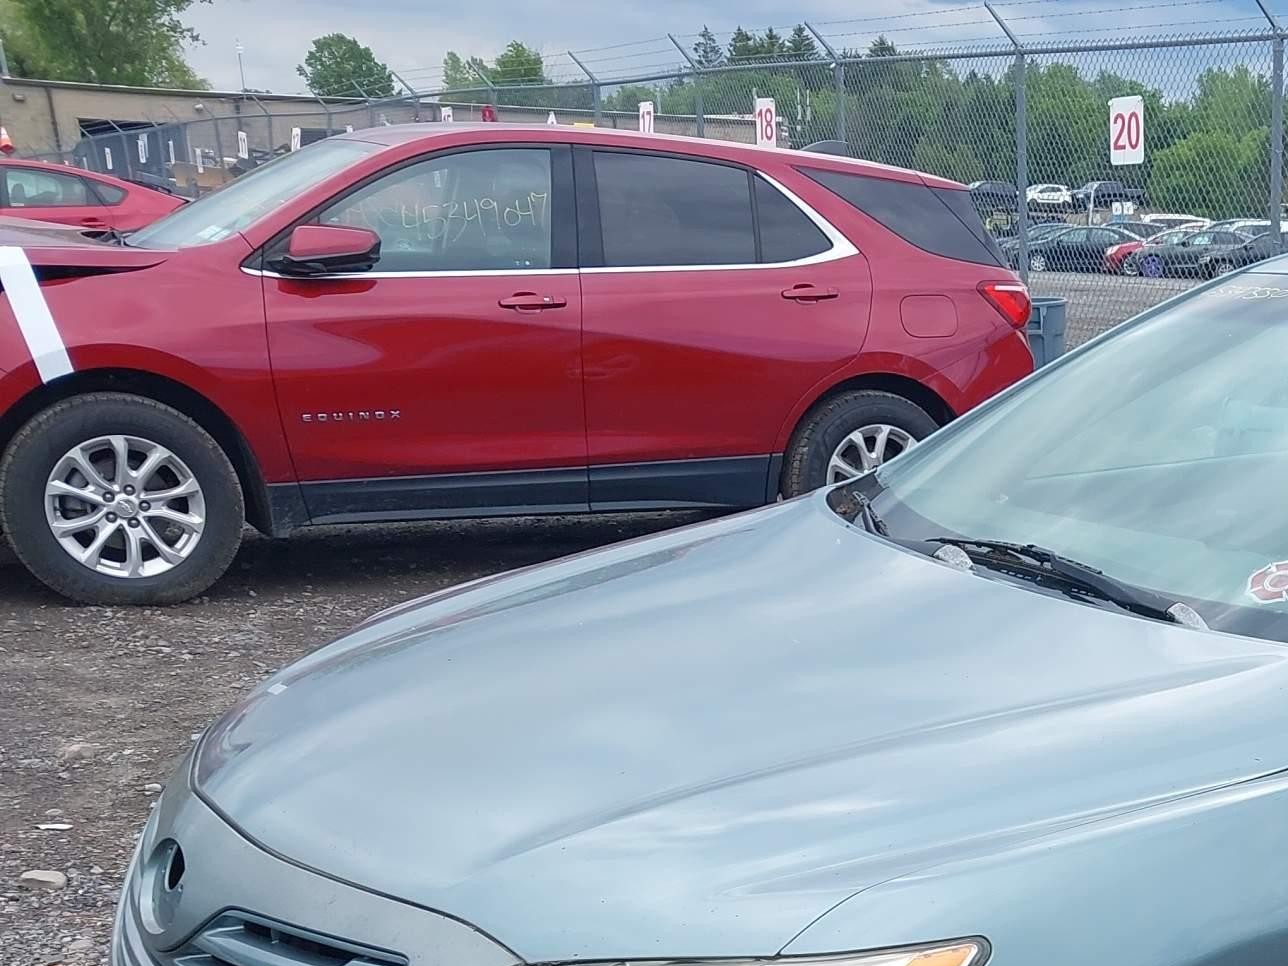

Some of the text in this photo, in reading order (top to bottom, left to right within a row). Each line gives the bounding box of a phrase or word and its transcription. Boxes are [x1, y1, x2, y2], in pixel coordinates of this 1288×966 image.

[757, 108, 774, 141] 18
[1112, 112, 1140, 150] 20
[302, 410, 400, 422] EQUINOX
